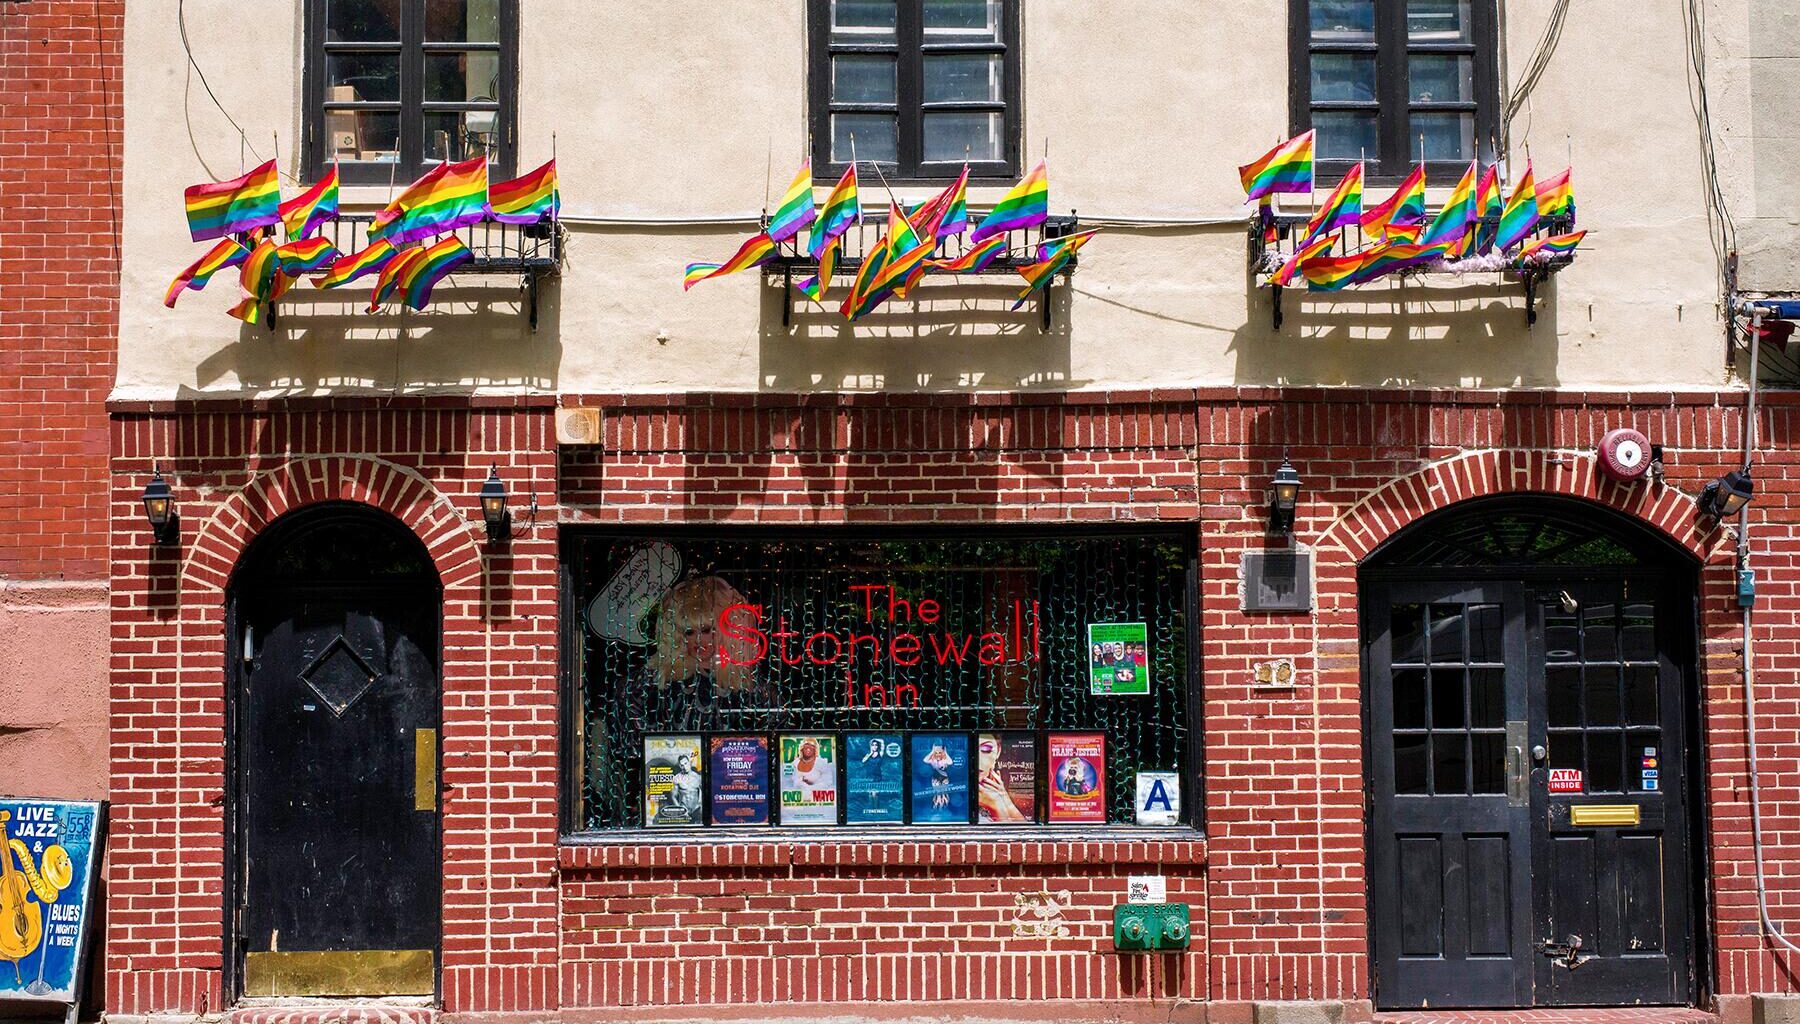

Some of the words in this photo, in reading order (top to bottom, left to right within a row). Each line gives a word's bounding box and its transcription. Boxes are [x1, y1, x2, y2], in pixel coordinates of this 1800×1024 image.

[849, 584, 940, 624] The
[717, 600, 1041, 669] Stonewall
[847, 670, 918, 709] Inn
[1051, 748, 1101, 757] TRANS-JESTER!
[727, 761, 753, 769] FRIDAY
[1551, 771, 1580, 780] ATM
[1551, 781, 1581, 789] INSIDE
[783, 791, 802, 803] CINCO
[812, 790, 835, 803] MAYO
[1144, 779, 1172, 811] A
[17, 807, 54, 821] LIVE
[15, 823, 58, 837] JAZZ
[69, 816, 84, 834] 55
[33, 841, 43, 853] &
[51, 904, 80, 922] BLUES
[1123, 904, 1149, 914] AUTO
[1154, 904, 1181, 914] SPKR
[49, 924, 54, 934] 7
[55, 924, 78, 935] NIGHTS
[48, 935, 54, 946] A
[56, 936, 75, 946] WEEK
